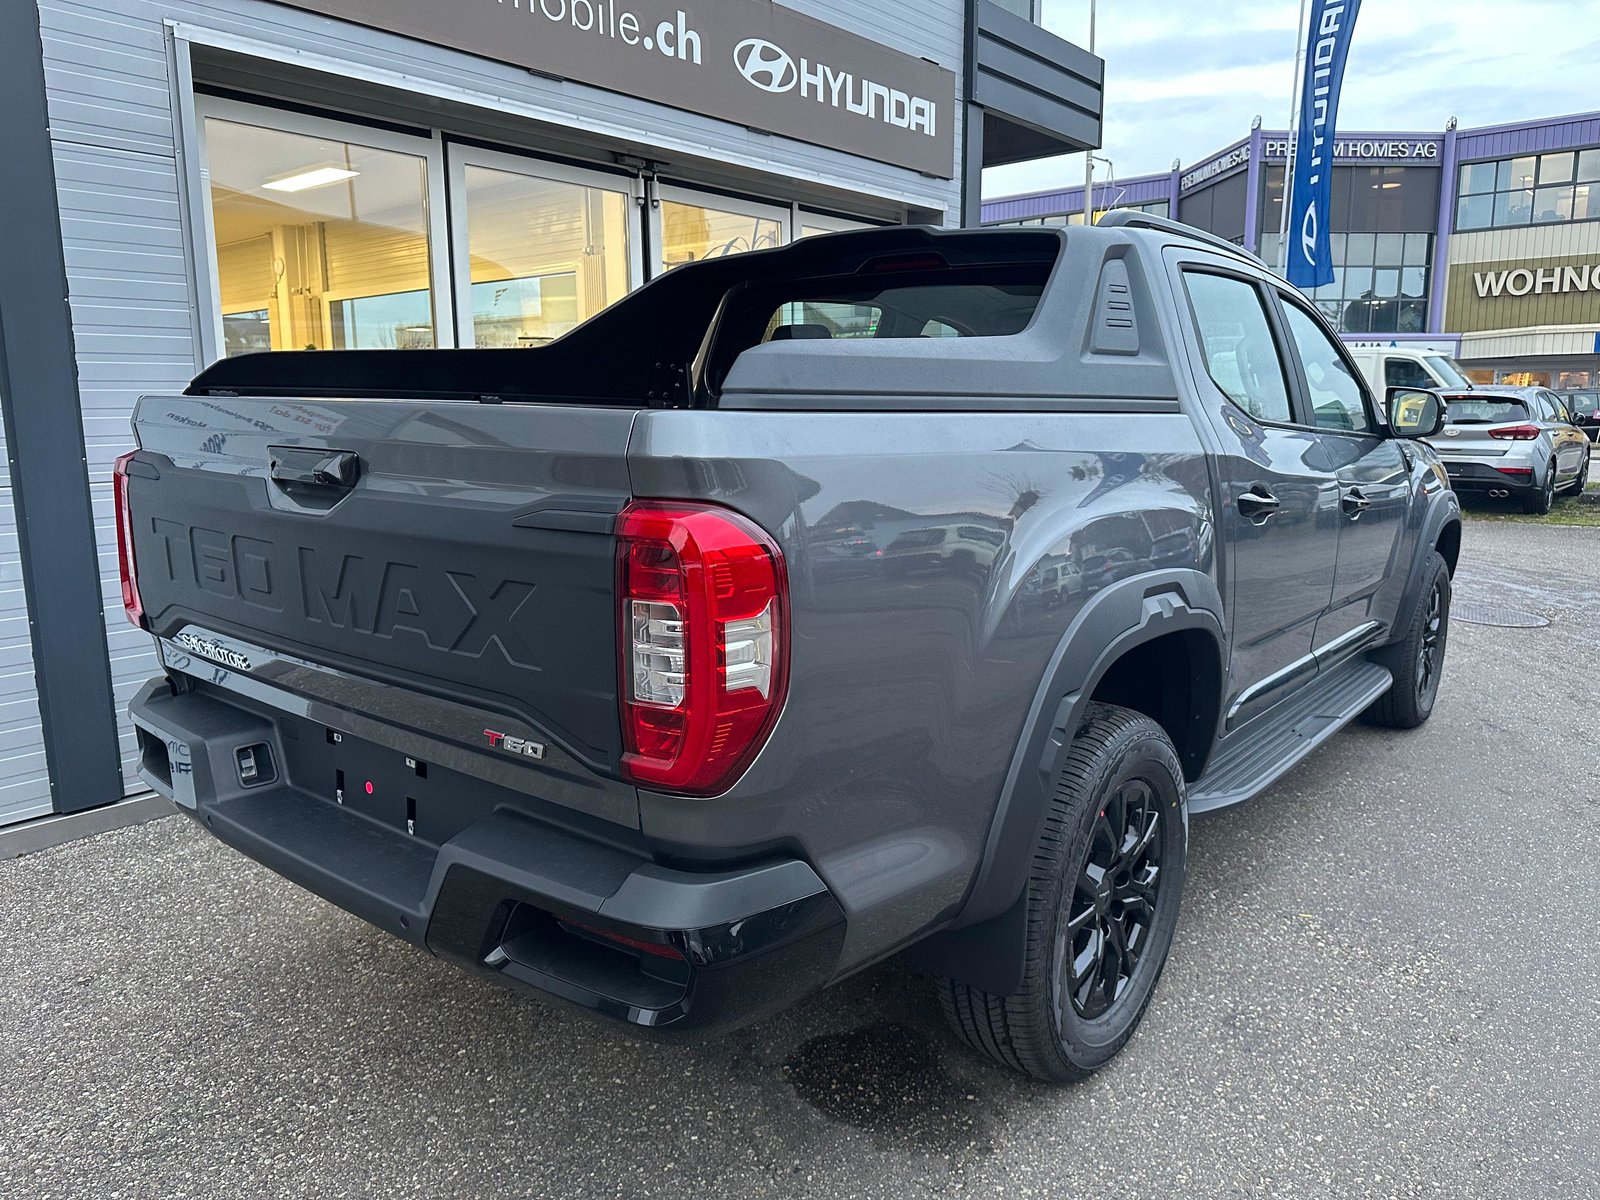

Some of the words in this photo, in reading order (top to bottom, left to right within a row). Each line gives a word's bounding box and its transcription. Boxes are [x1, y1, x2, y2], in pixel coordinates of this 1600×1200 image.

[800, 57, 936, 137] HYUNDAI
[1265, 142, 1345, 157] PREM
[1350, 142, 1409, 158] HOMES
[1412, 142, 1437, 158] AG
[151, 516, 285, 613] T60
[297, 546, 543, 672] MAX
[483, 728, 545, 760] T60
